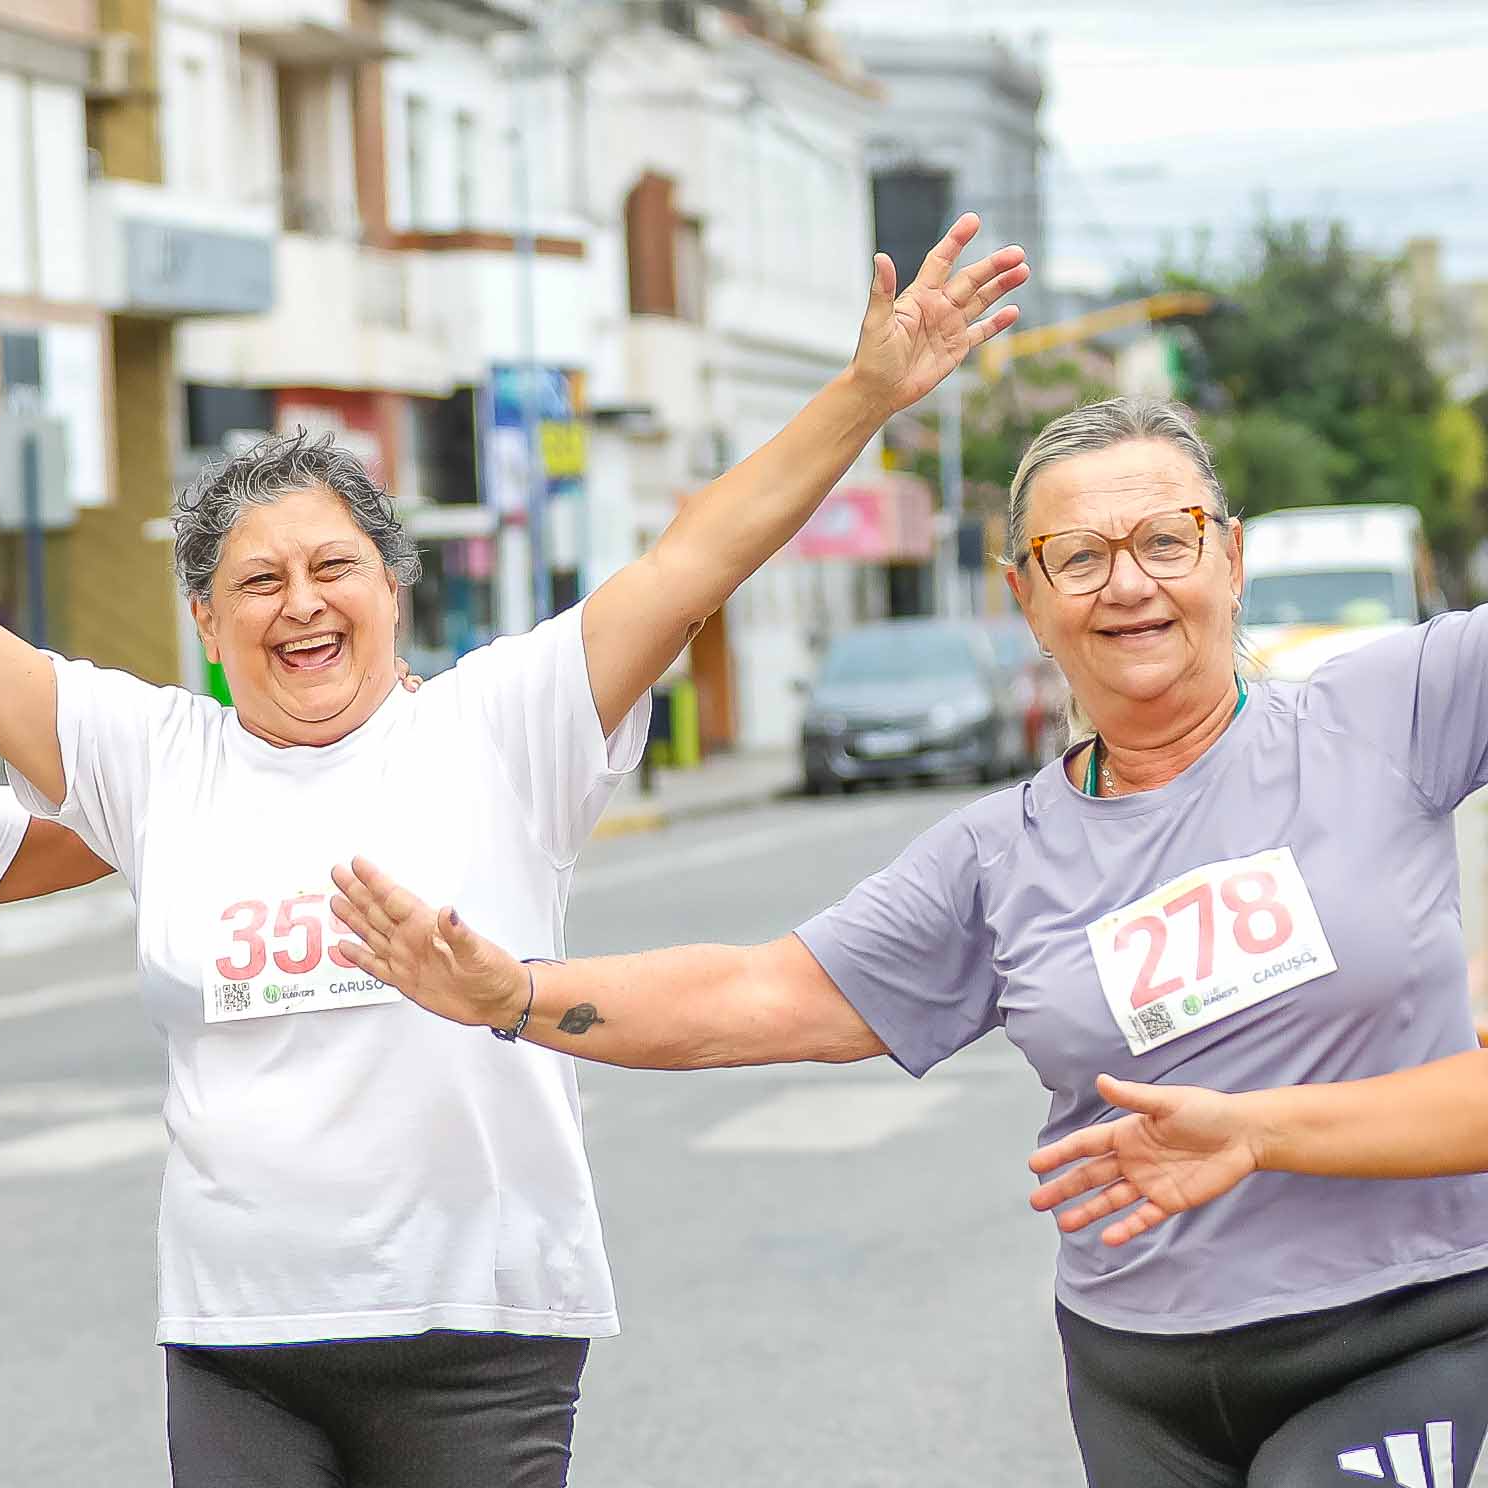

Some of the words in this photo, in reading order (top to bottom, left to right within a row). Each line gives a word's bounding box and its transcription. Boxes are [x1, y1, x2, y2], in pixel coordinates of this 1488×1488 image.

[1113, 870, 1294, 1010] 278
[1252, 951, 1313, 985] CARUSO
[329, 979, 385, 995] CARUSO
